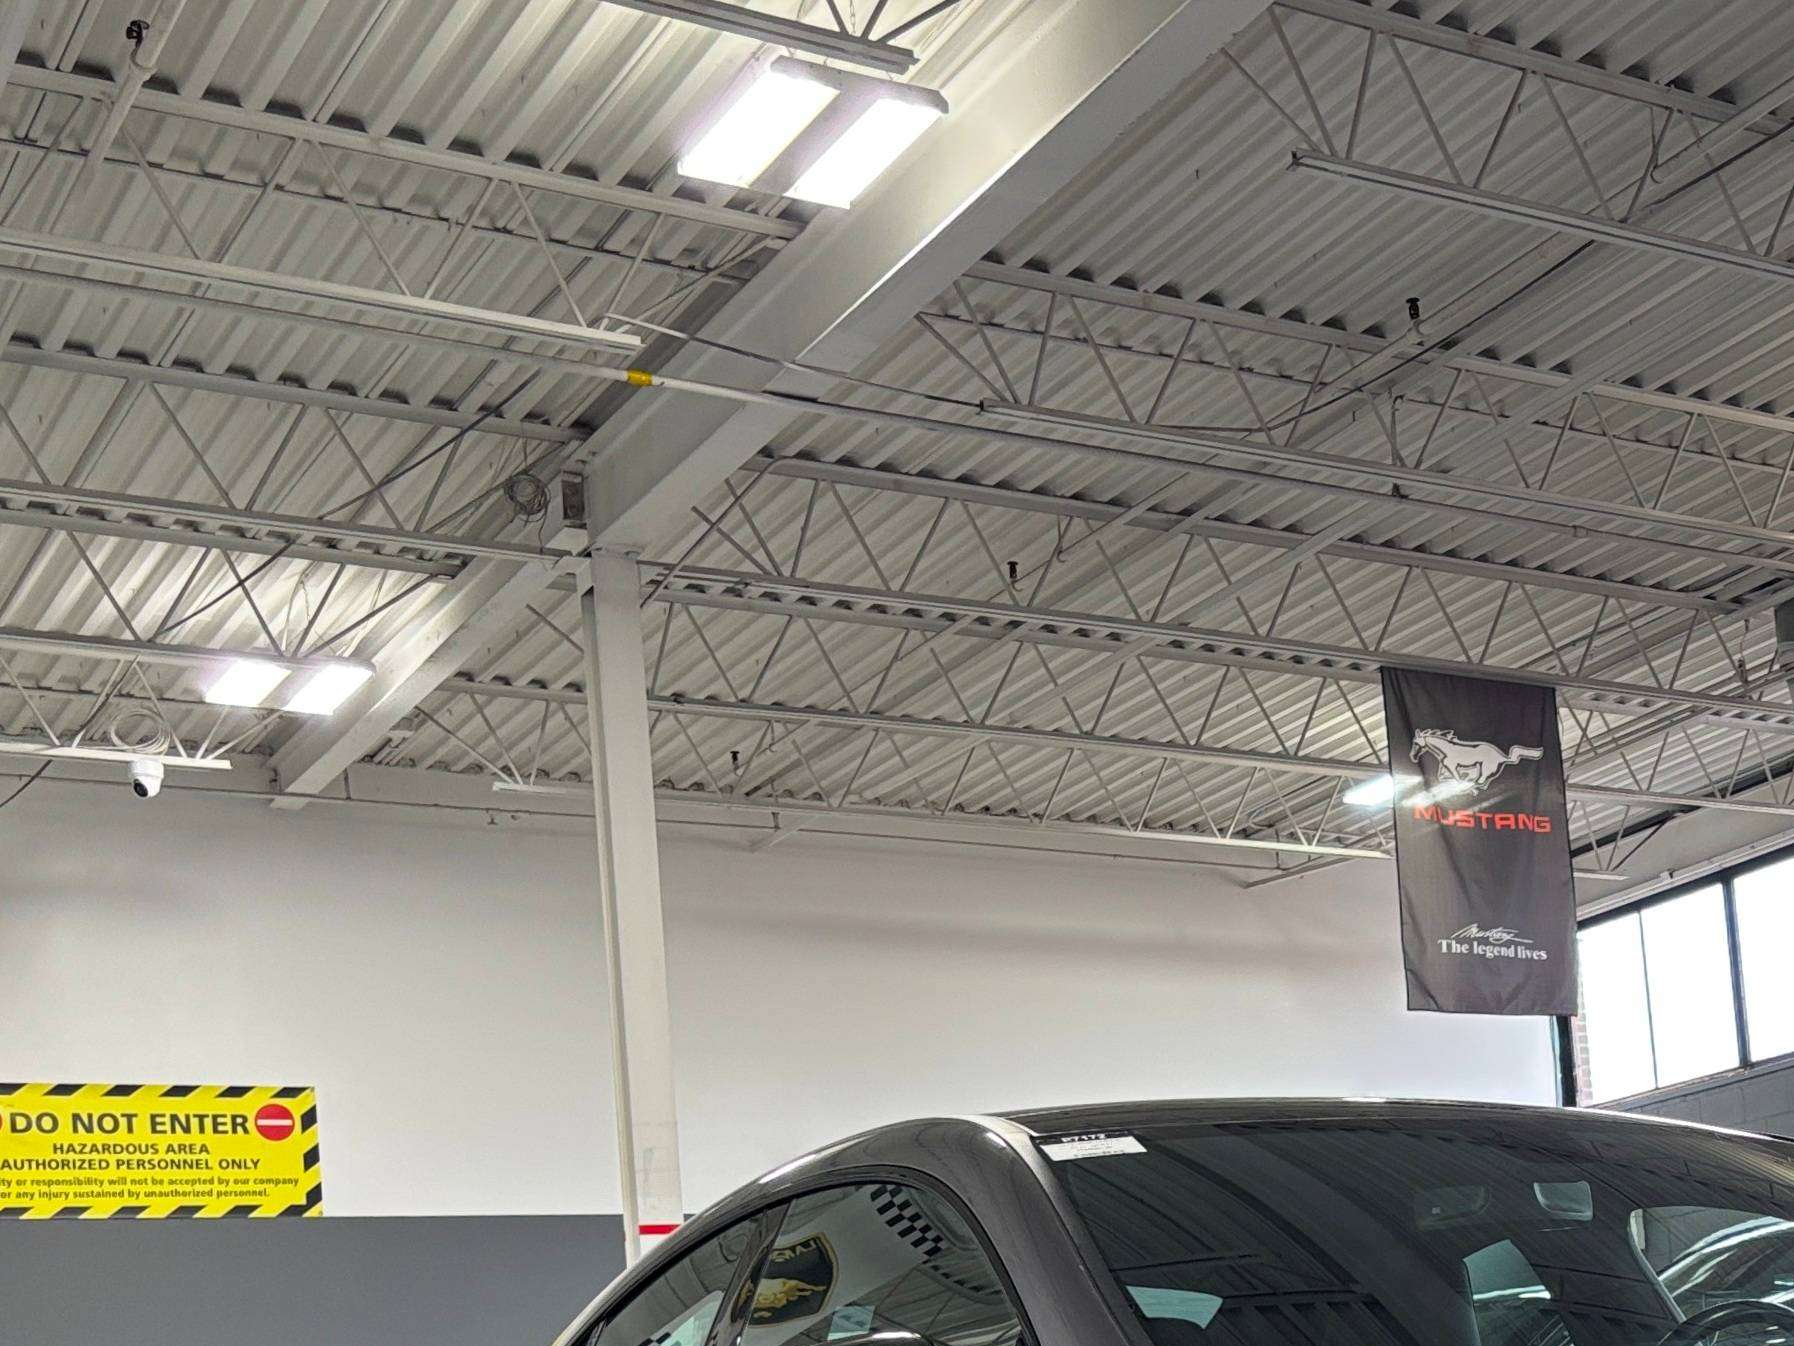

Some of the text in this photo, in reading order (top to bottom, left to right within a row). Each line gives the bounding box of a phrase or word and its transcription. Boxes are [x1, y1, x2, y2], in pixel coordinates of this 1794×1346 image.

[1413, 803, 1552, 834] MUSTANG
[1450, 922, 1535, 945] Mustang
[1437, 938, 1549, 960] The legend lives
[9, 1111, 250, 1135] DO NOT ENTER
[52, 1142, 211, 1155] HAZARDOUS AREA
[115, 1157, 213, 1171] PERSONNEL
[218, 1157, 261, 1170] ONLY
[16, 1178, 27, 1186] or
[30, 1176, 105, 1188] responsibility
[107, 1176, 127, 1186] will
[130, 1177, 148, 1186] not
[151, 1175, 165, 1186] be
[168, 1175, 214, 1187] accepted
[217, 1175, 230, 1188] by
[233, 1177, 251, 1186] our
[253, 1177, 299, 1188] company
[16, 1190, 35, 1201] any
[38, 1189, 70, 1201] injury
[73, 1188, 125, 1199] sustained
[128, 1187, 141, 1200] by
[144, 1187, 213, 1198] unauthorized
[216, 1187, 270, 1199] personnel.
